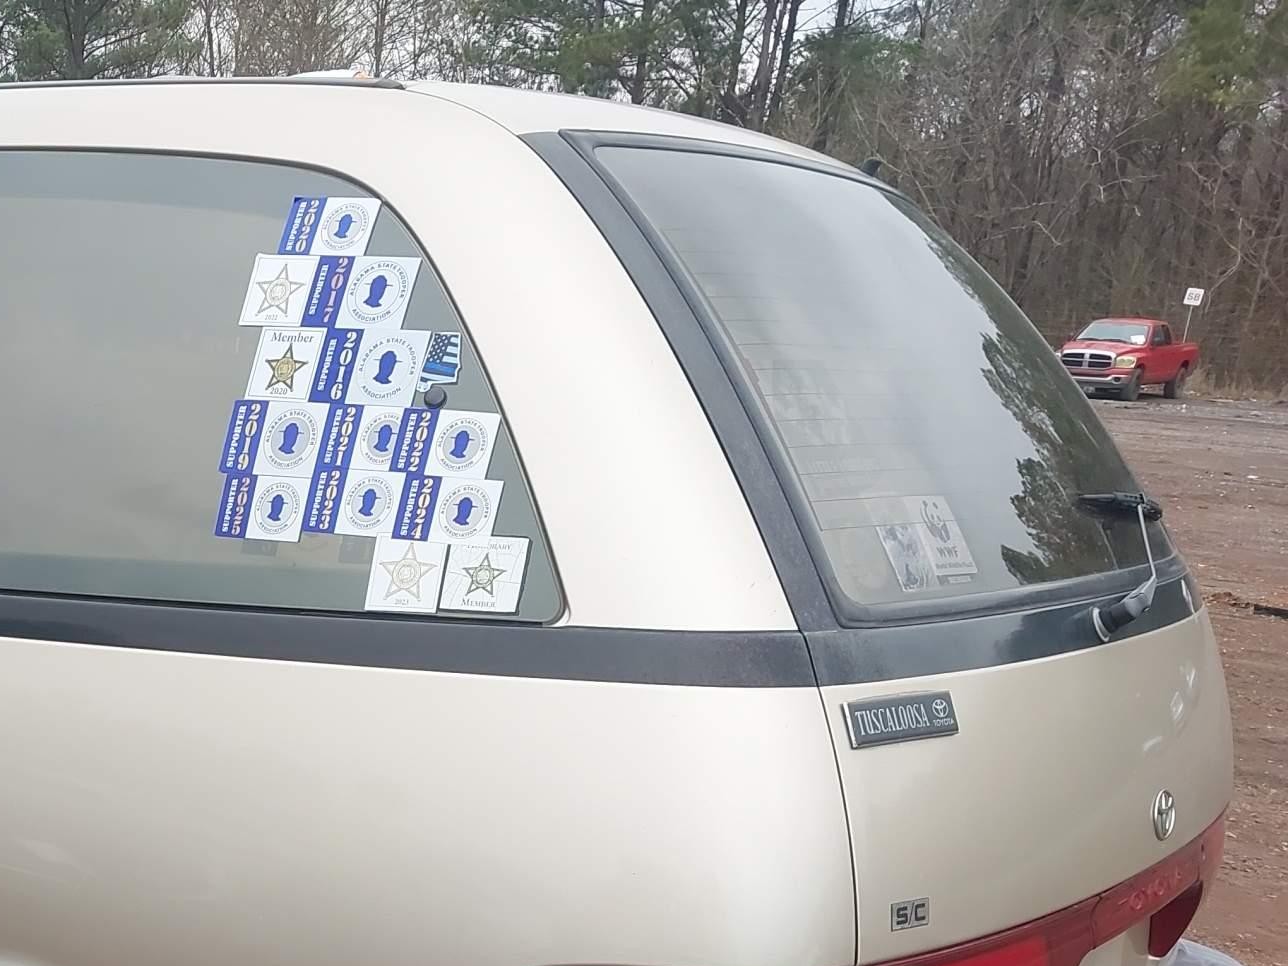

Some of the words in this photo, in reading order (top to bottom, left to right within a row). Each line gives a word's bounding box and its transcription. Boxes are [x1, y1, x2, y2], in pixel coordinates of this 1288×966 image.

[285, 201, 308, 251] SUPPORTER
[295, 199, 320, 252] 2020
[308, 264, 329, 315] SUPPORTER
[322, 256, 349, 323] 2017
[270, 331, 314, 343] Member
[317, 338, 337, 391] SUPPORTER
[269, 387, 288, 395] 2020
[330, 331, 357, 400] 2016
[225, 405, 247, 468] SUPPORTER
[237, 403, 261, 470] 2019
[324, 408, 343, 464] SUPPORTER
[335, 407, 356, 466] 2021
[397, 413, 418, 469] SUPPORTER
[407, 411, 431, 472] 2022
[222, 478, 238, 532] SUPPORTER
[231, 477, 250, 535] 2025
[309, 472, 328, 527] SUPPORTER
[319, 470, 340, 530] 2023
[400, 480, 419, 536] SUPPORTER
[411, 478, 433, 539] 2024
[854, 704, 930, 735] TUSCALOOSA
[933, 718, 954, 727] TOYOTA
[896, 902, 926, 925] S/C
